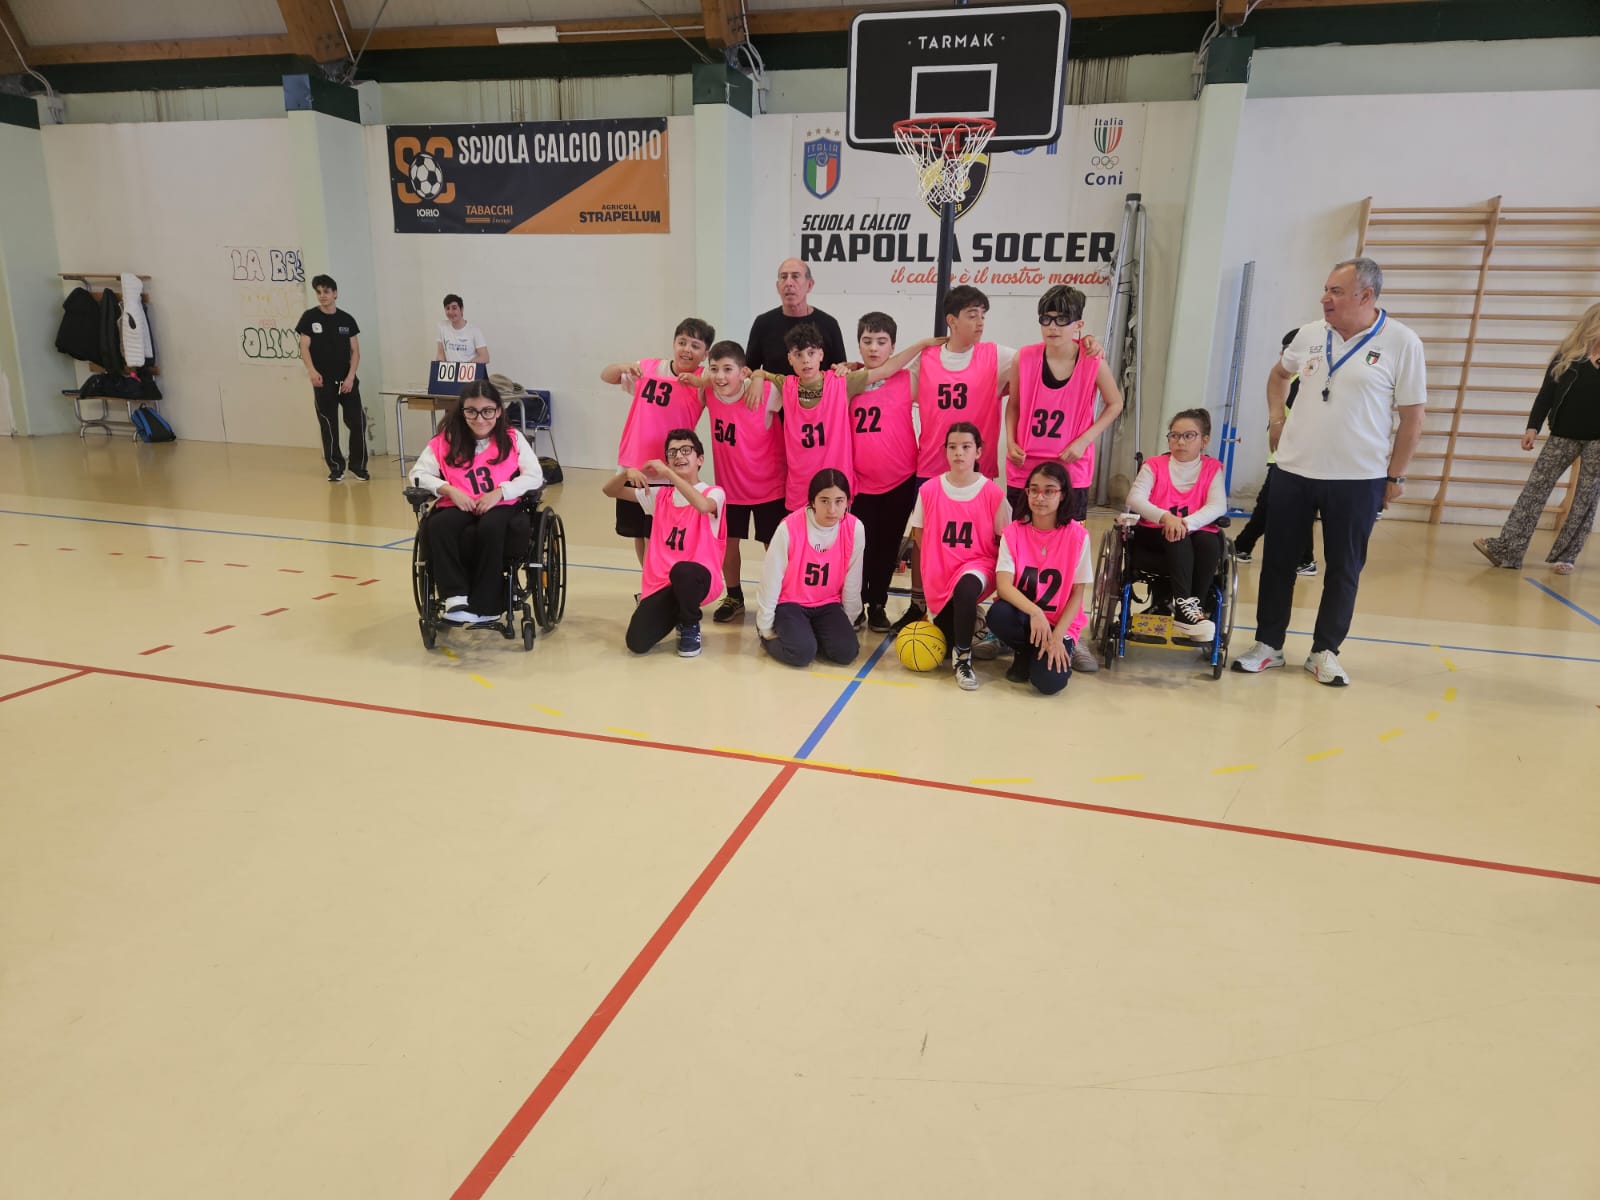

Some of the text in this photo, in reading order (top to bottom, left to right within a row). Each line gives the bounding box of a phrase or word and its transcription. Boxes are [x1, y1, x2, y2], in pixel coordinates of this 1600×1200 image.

[918, 33, 994, 49] TARMAK
[1094, 117, 1124, 126] Italia
[457, 129, 662, 165] SCUOLA CALCIO IORIO
[807, 143, 838, 153] ITALIA
[1084, 171, 1123, 186] Coni
[416, 208, 440, 218] IORIO
[464, 204, 514, 216] TABACCHI
[579, 210, 661, 224] STRAPELLUM
[601, 203, 638, 211] AGRICOLA
[801, 213, 911, 231] SCUOLA CALCIO
[972, 232, 1116, 263] SOCCER
[231, 249, 265, 282] LA
[890, 265, 906, 284] il
[958, 268, 970, 284] è
[973, 266, 990, 284] il
[991, 266, 1045, 284] nostro
[439, 364, 474, 381] 00 00
[641, 379, 673, 407] 43
[937, 382, 968, 410] 53
[714, 418, 737, 447] 54
[853, 406, 882, 434] 22
[1031, 408, 1065, 439] 32
[801, 421, 826, 449] 31
[464, 466, 495, 495] 13
[665, 526, 687, 551] 41
[942, 520, 973, 549] 44
[804, 562, 830, 587] 51
[1017, 565, 1062, 612] 42
